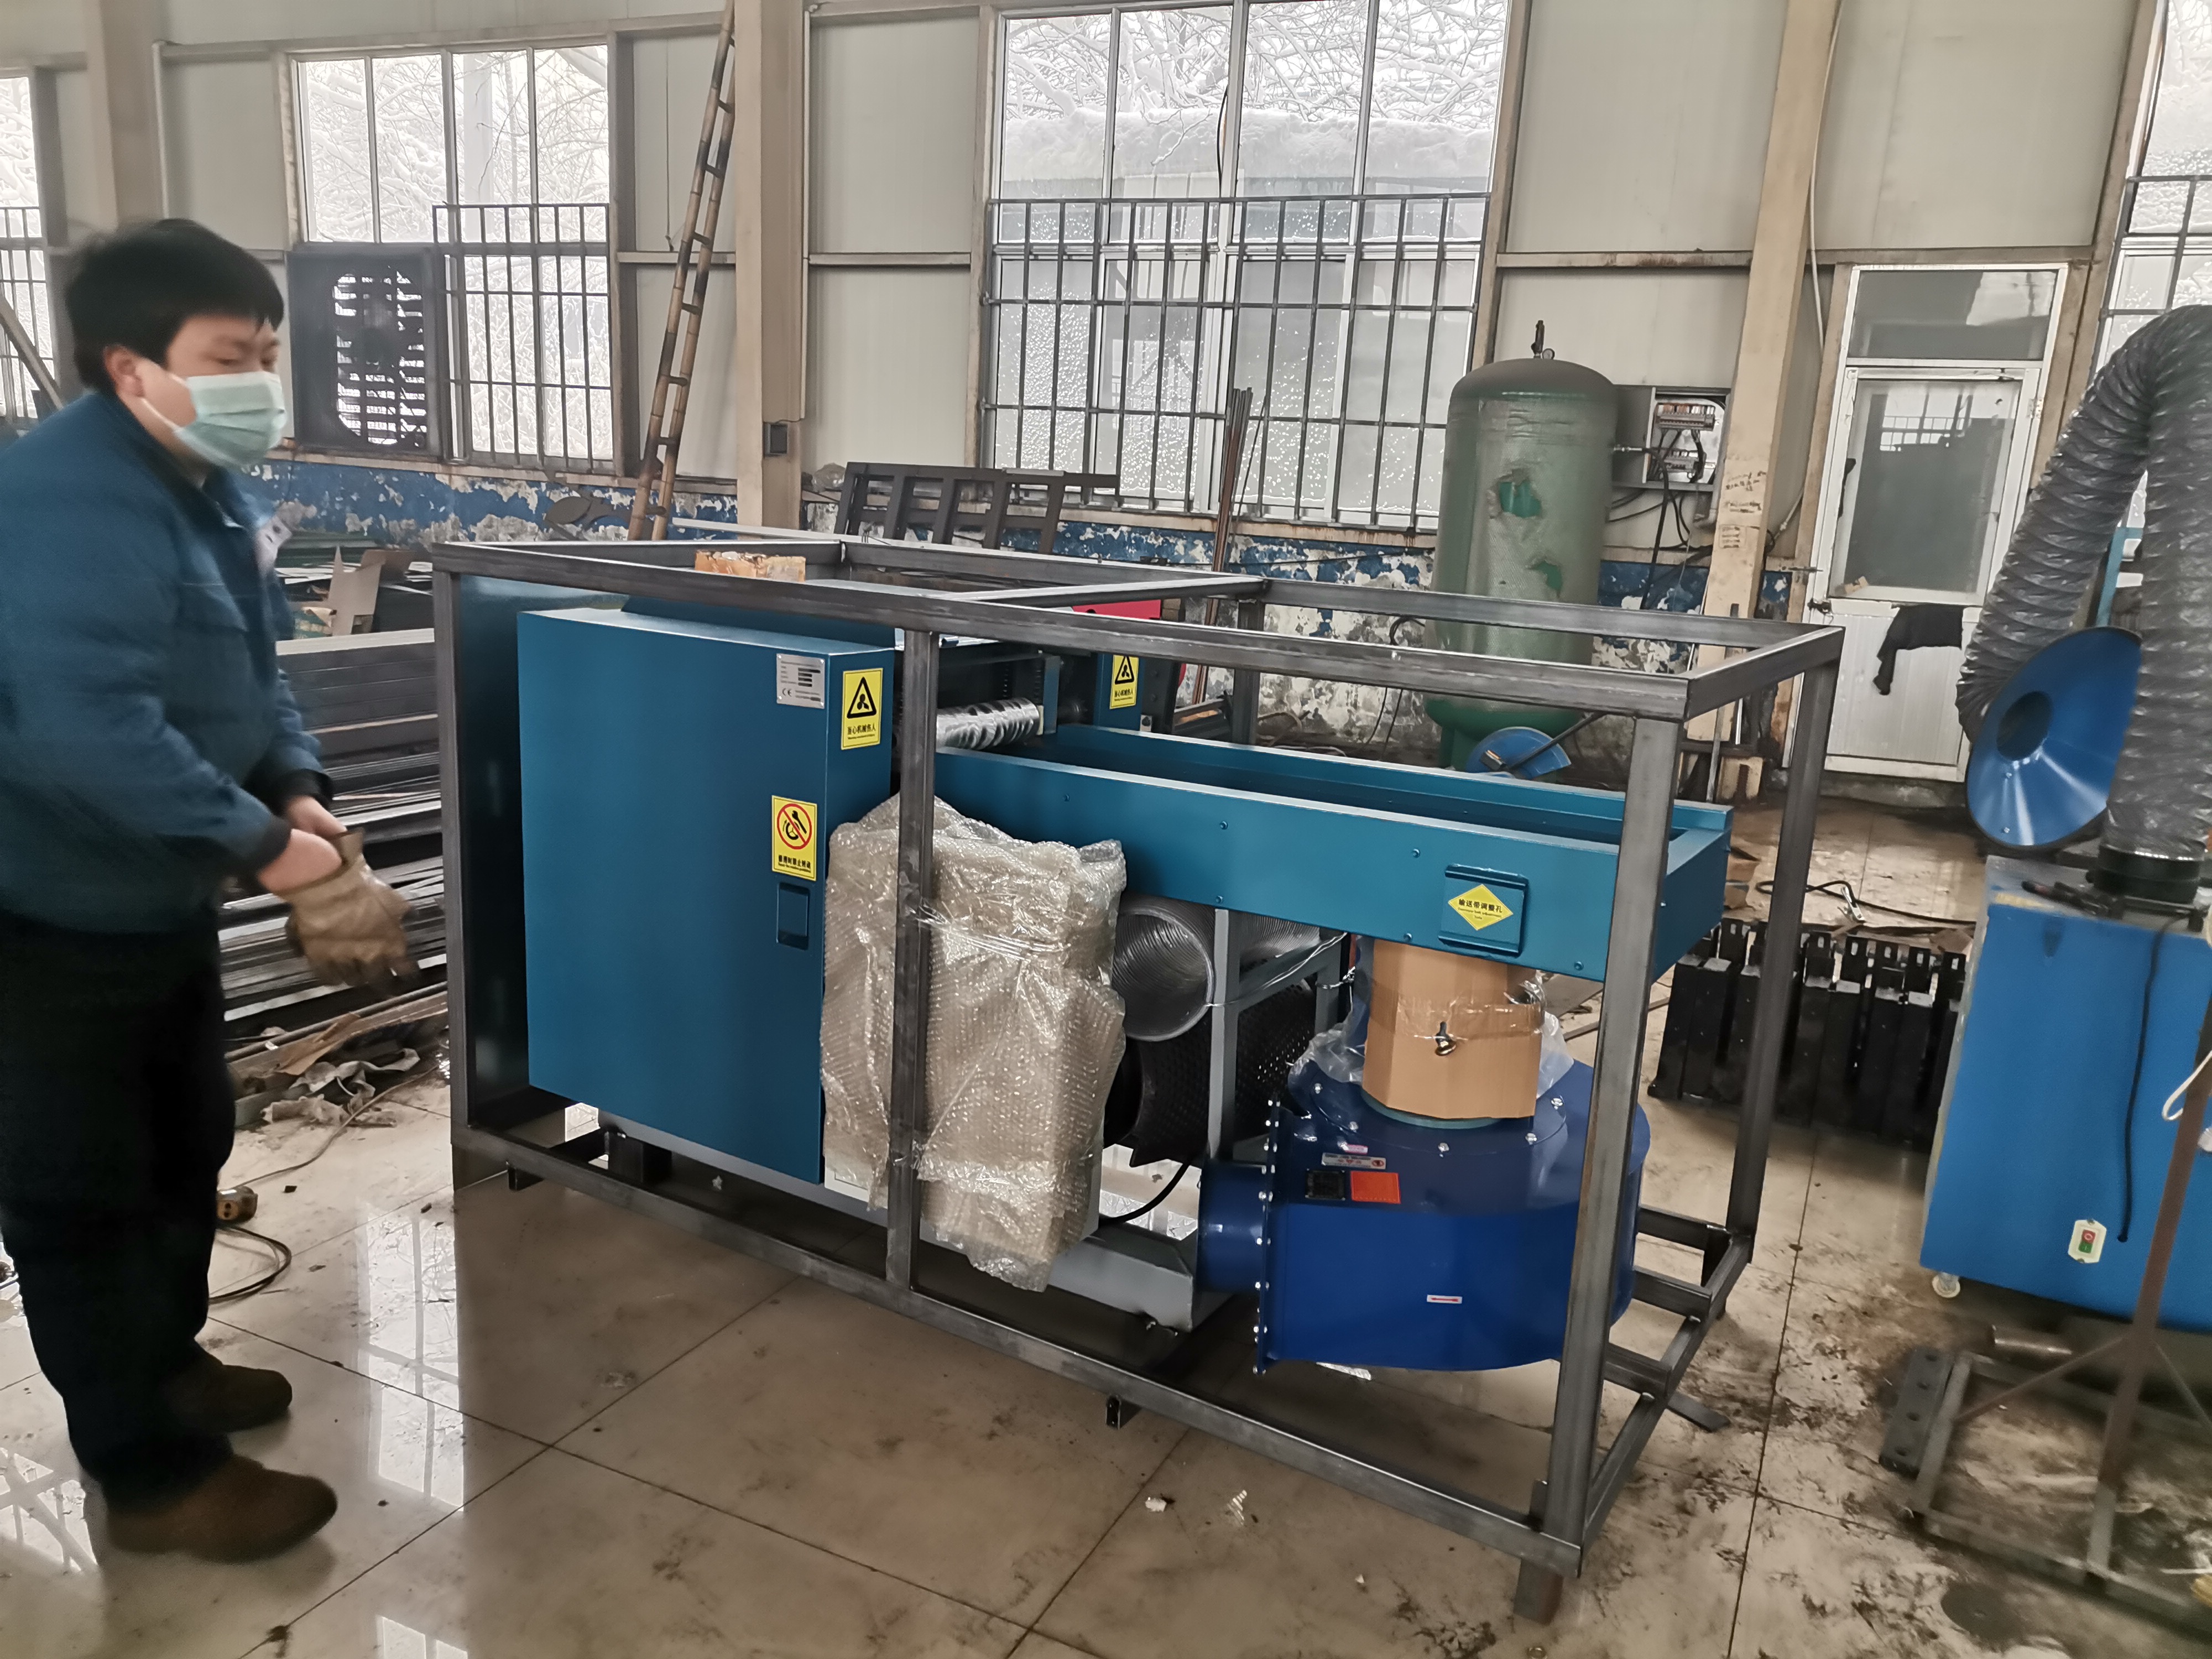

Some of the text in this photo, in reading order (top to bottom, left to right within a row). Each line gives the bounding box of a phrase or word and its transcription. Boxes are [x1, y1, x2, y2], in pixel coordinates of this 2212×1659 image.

[1459, 899, 1503, 913] 输送带调整孔
